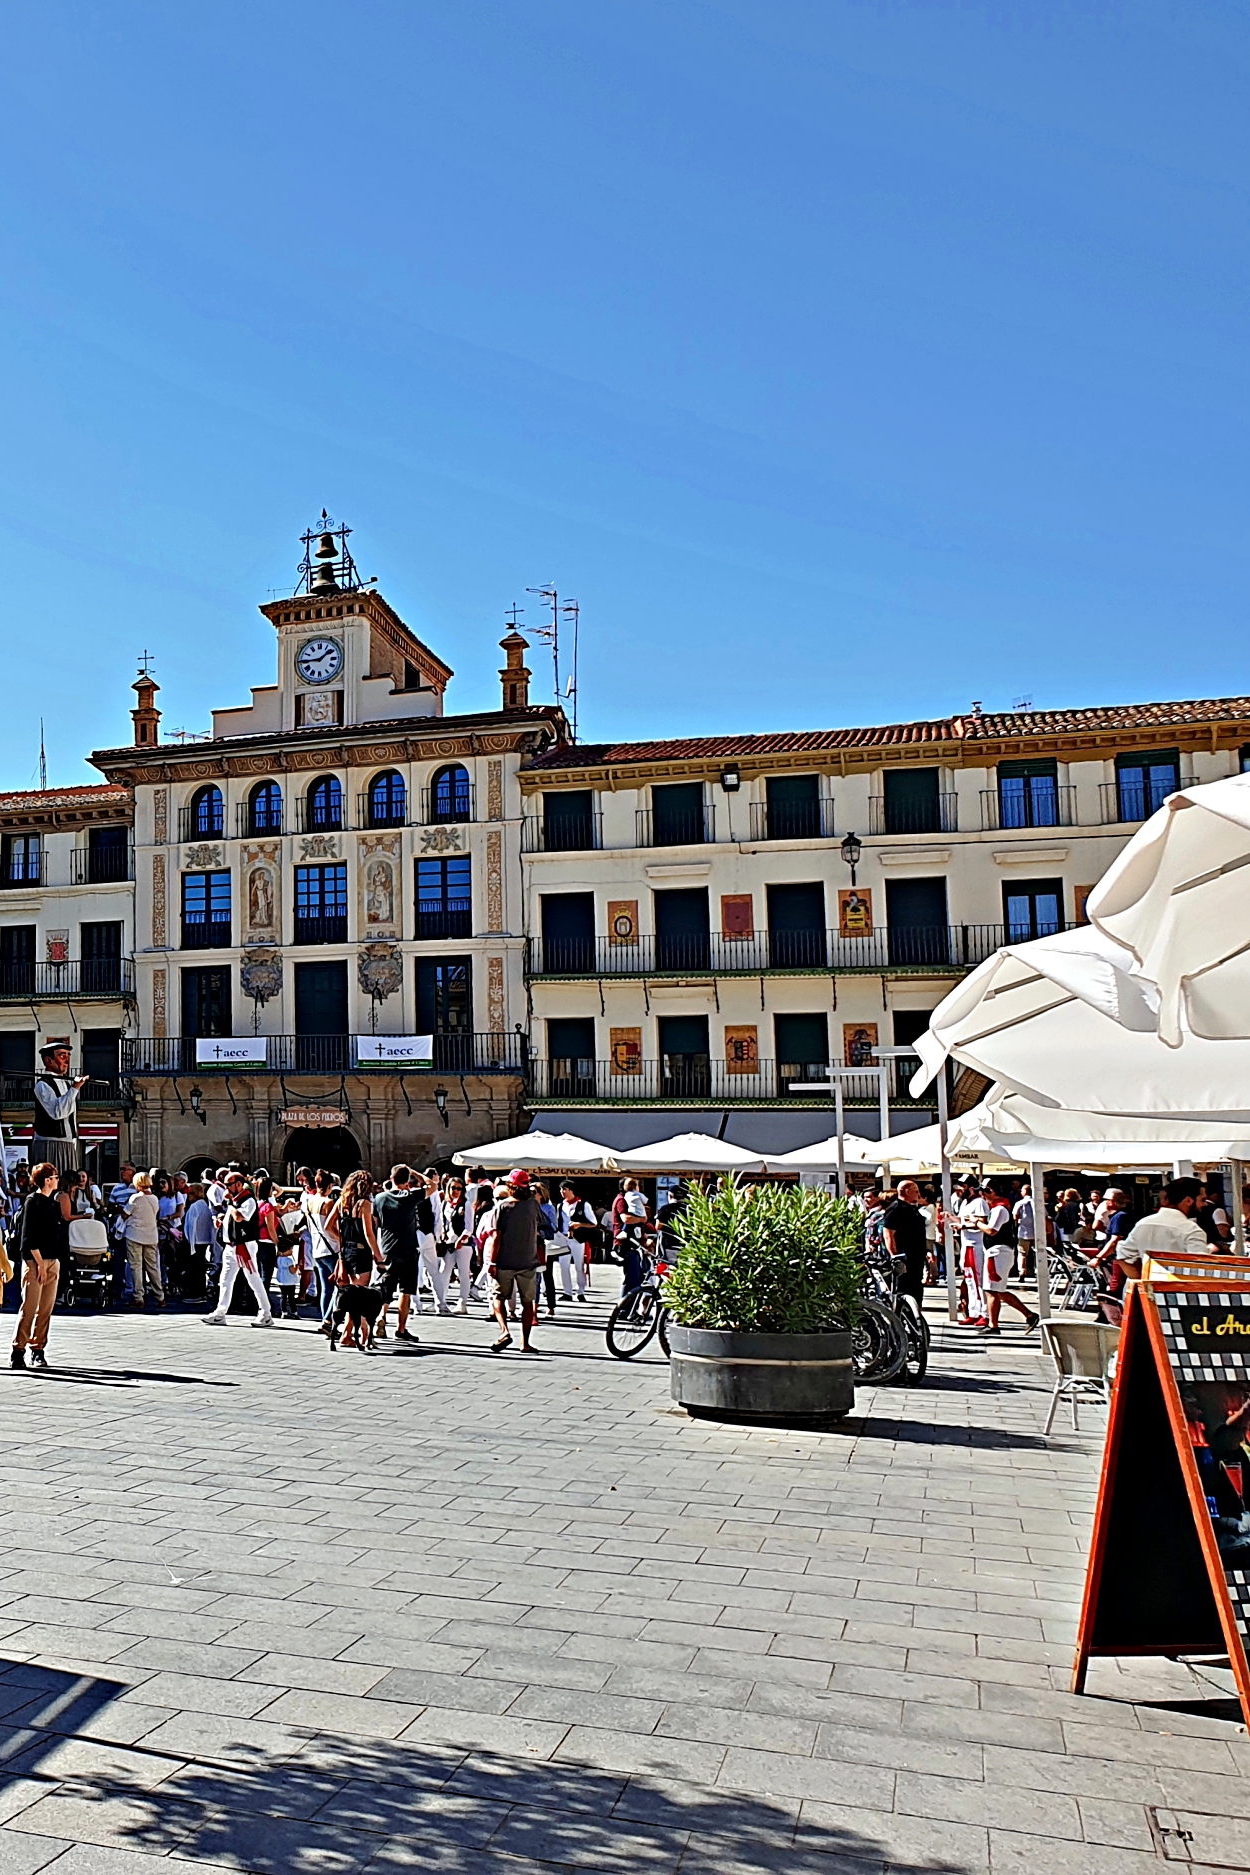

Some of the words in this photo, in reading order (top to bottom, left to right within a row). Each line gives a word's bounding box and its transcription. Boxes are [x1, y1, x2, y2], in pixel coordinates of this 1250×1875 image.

[223, 1049, 249, 1058] aecc
[386, 1048, 414, 1056] aecc
[281, 1112, 298, 1121] PLAZA
[298, 1112, 306, 1121] DE
[306, 1112, 321, 1121] LOS
[321, 1112, 345, 1122] FUEROS
[1191, 1316, 1212, 1335] el
